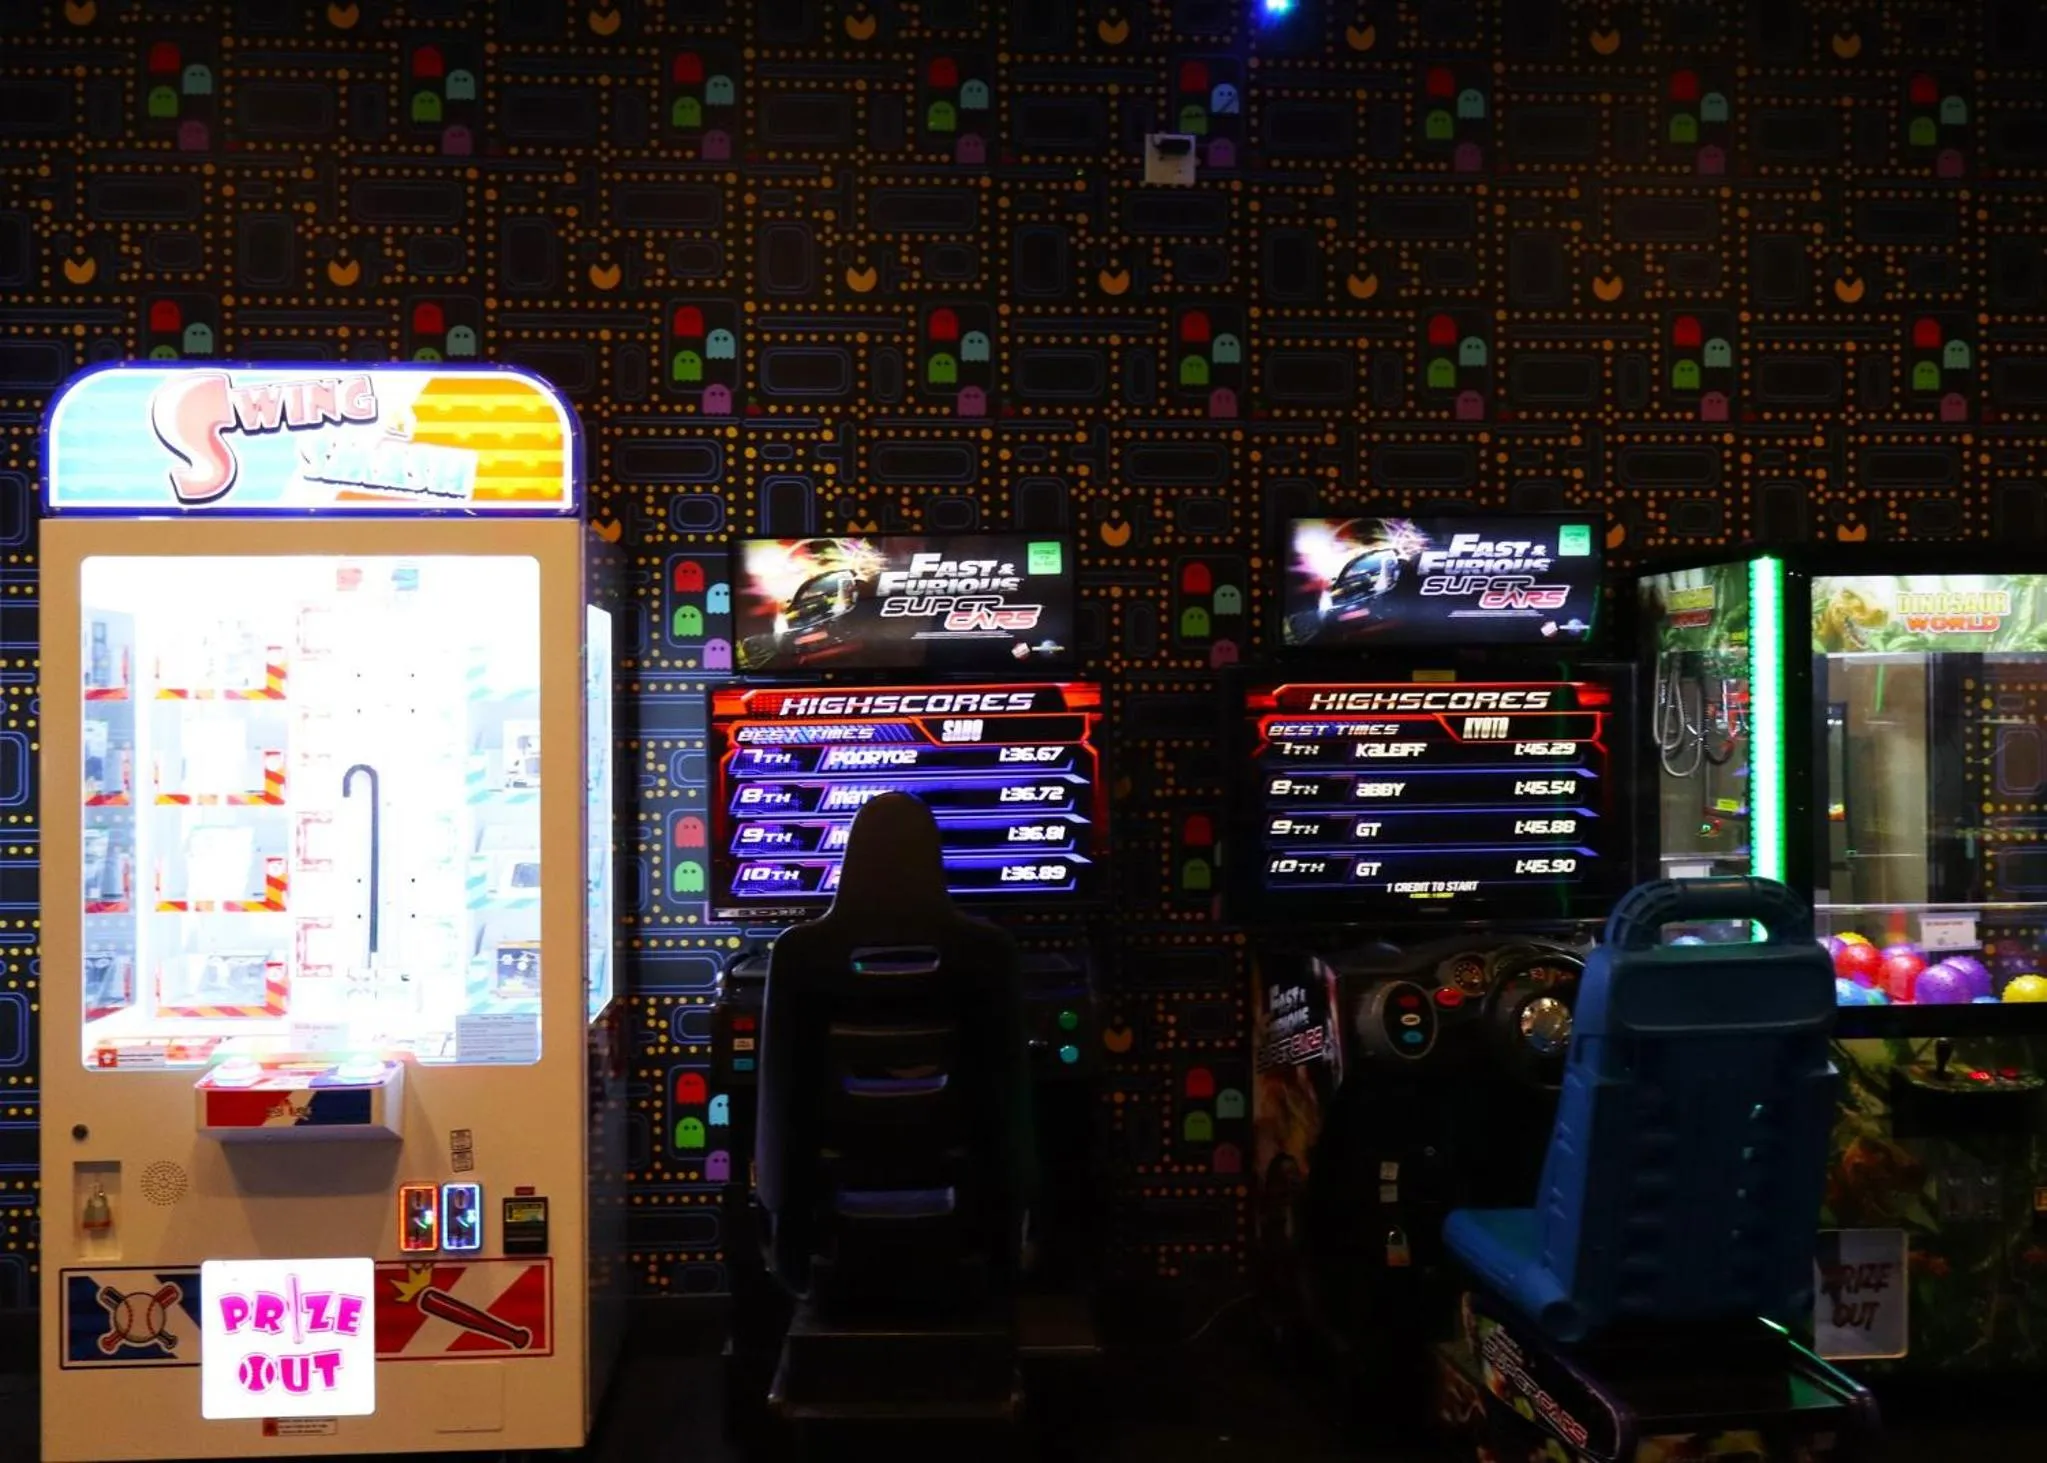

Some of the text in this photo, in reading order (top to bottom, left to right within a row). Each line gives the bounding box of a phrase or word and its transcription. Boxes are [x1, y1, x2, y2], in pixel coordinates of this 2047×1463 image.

[152, 373, 378, 504] SWING
[1447, 533, 1547, 557] FAST &
[909, 553, 1015, 578] FAST &
[1417, 551, 1551, 575] FURIOUS
[876, 571, 1021, 596] FURIOUS
[1420, 575, 1535, 595] SUPER
[881, 595, 1004, 617] SUPER
[1479, 586, 1570, 609] CARS
[1897, 591, 2010, 615] DINOSAUR
[945, 605, 1043, 630] CARS
[1905, 613, 2000, 633] WORLD
[779, 693, 1036, 716] HIGHSCORES
[1309, 691, 1551, 711] HIGHSCORES
[738, 727, 875, 741] BEST TIMES
[1268, 723, 1400, 736] BEST TIMES
[1462, 717, 1510, 739] KYOTO
[742, 749, 791, 764] 7TH
[740, 788, 791, 803] 8TH
[1270, 780, 1319, 795] 8TH
[741, 828, 793, 843] 9TH
[1270, 820, 1319, 835] 9TH
[1356, 822, 1382, 837] GT
[742, 867, 800, 881] 10TH
[1270, 859, 1325, 873] 10TH
[1356, 862, 1382, 877] GT
[1394, 882, 1431, 892] CREDIT
[1431, 882, 1445, 892] TO
[1446, 881, 1479, 891] START
[219, 1274, 366, 1344] PRIZE
[1833, 1302, 1880, 1330] OUT
[238, 1351, 343, 1395] OUT
